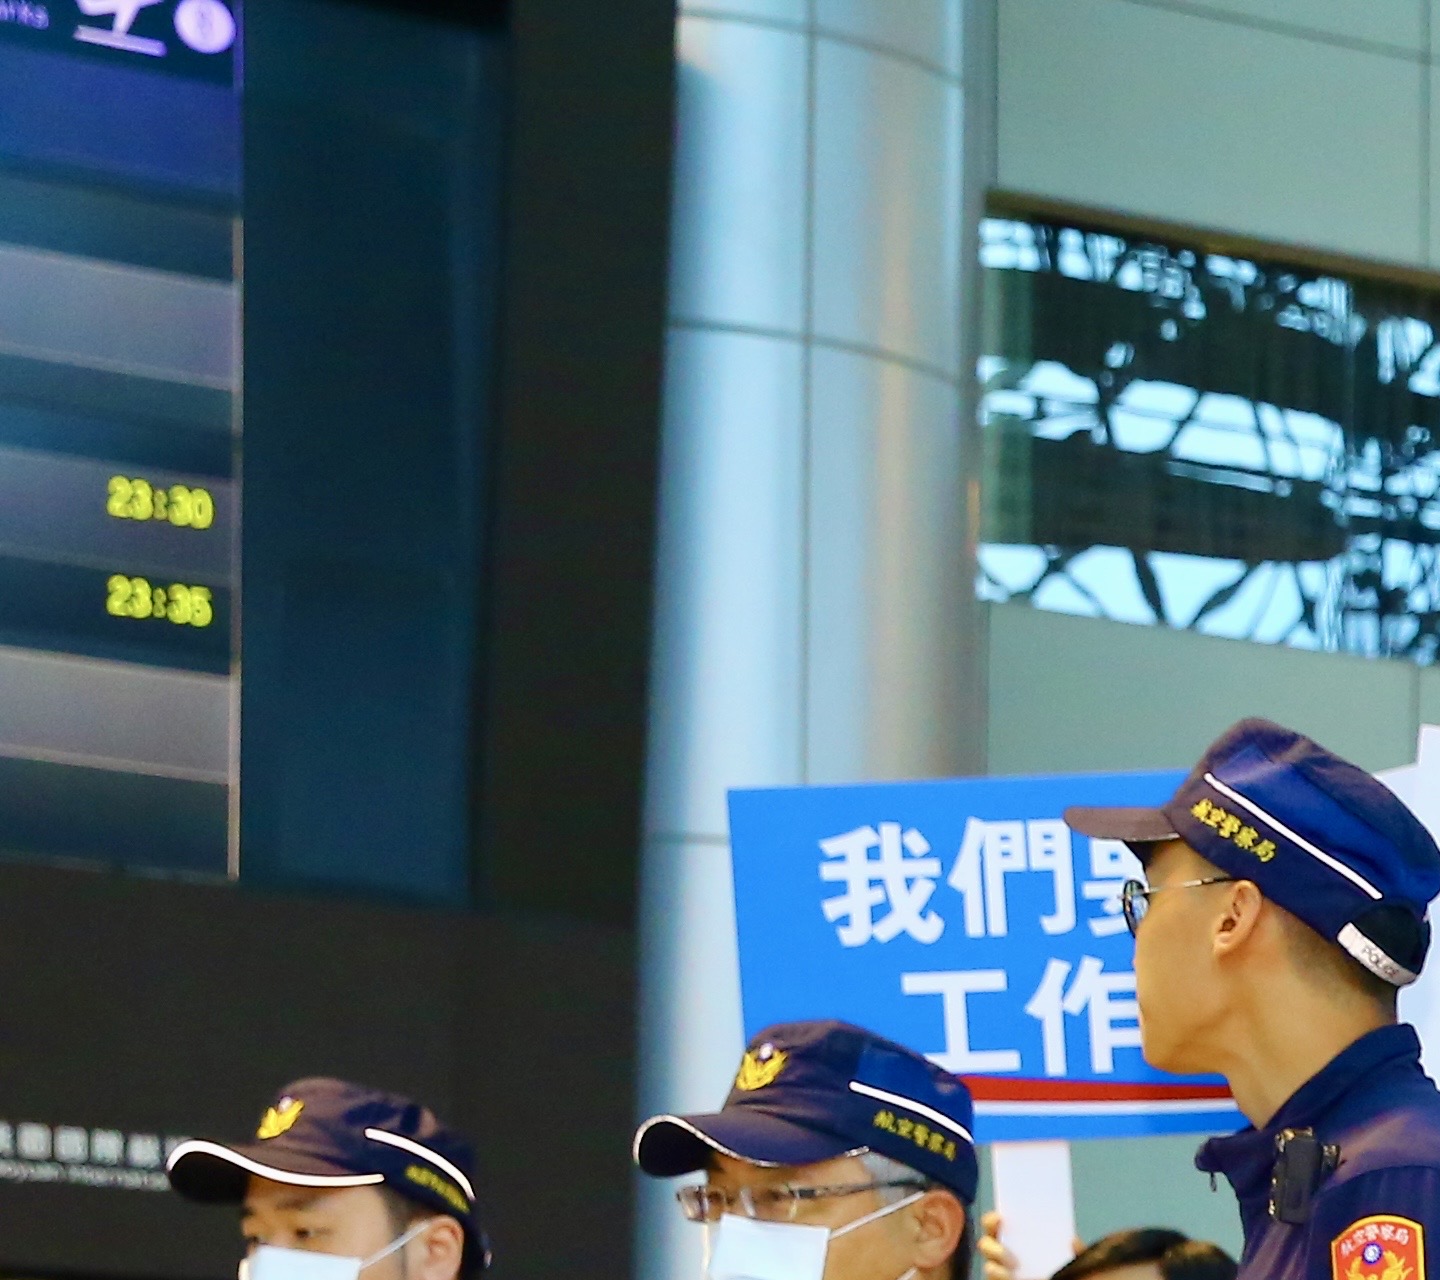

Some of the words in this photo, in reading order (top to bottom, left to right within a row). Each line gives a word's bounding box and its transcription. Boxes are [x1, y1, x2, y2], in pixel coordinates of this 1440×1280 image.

[105, 475, 213, 531] 23:30
[106, 574, 213, 627] 23:35
[903, 956, 1142, 1076] 工作
